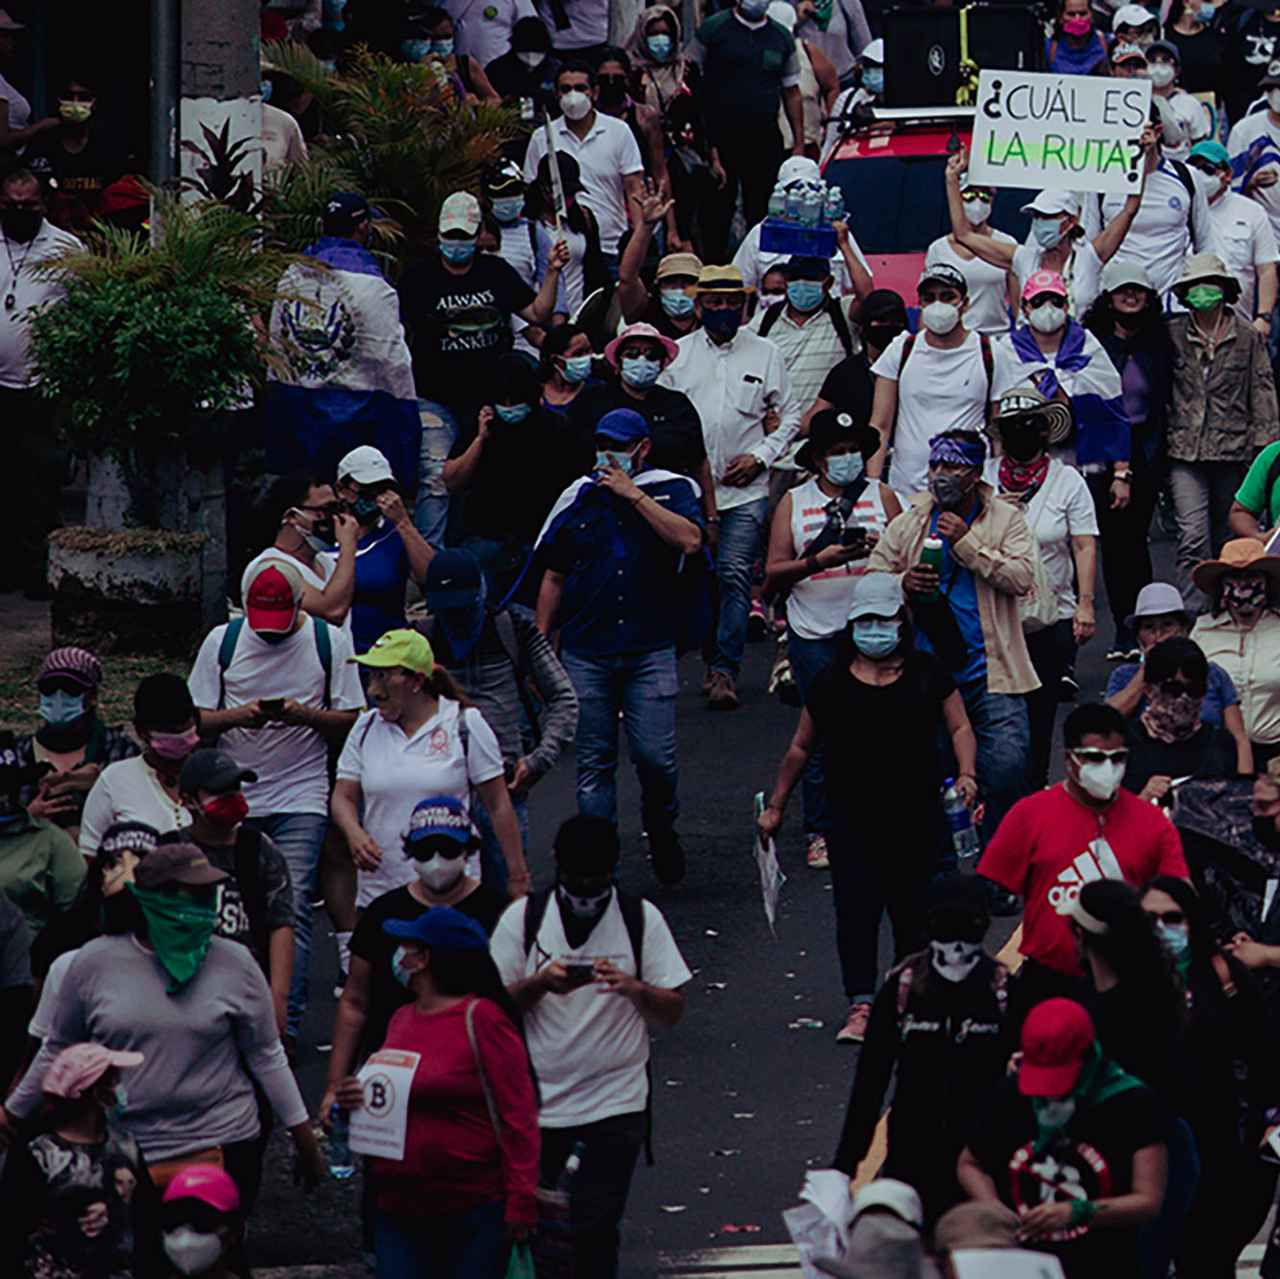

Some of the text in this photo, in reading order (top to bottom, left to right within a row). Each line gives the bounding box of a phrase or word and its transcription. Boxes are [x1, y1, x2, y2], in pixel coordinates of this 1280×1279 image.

[983, 80, 1145, 128] ¿CUÁL ES
[987, 130, 1144, 182] LA RUTA?
[436, 289, 496, 311] ALWAYS
